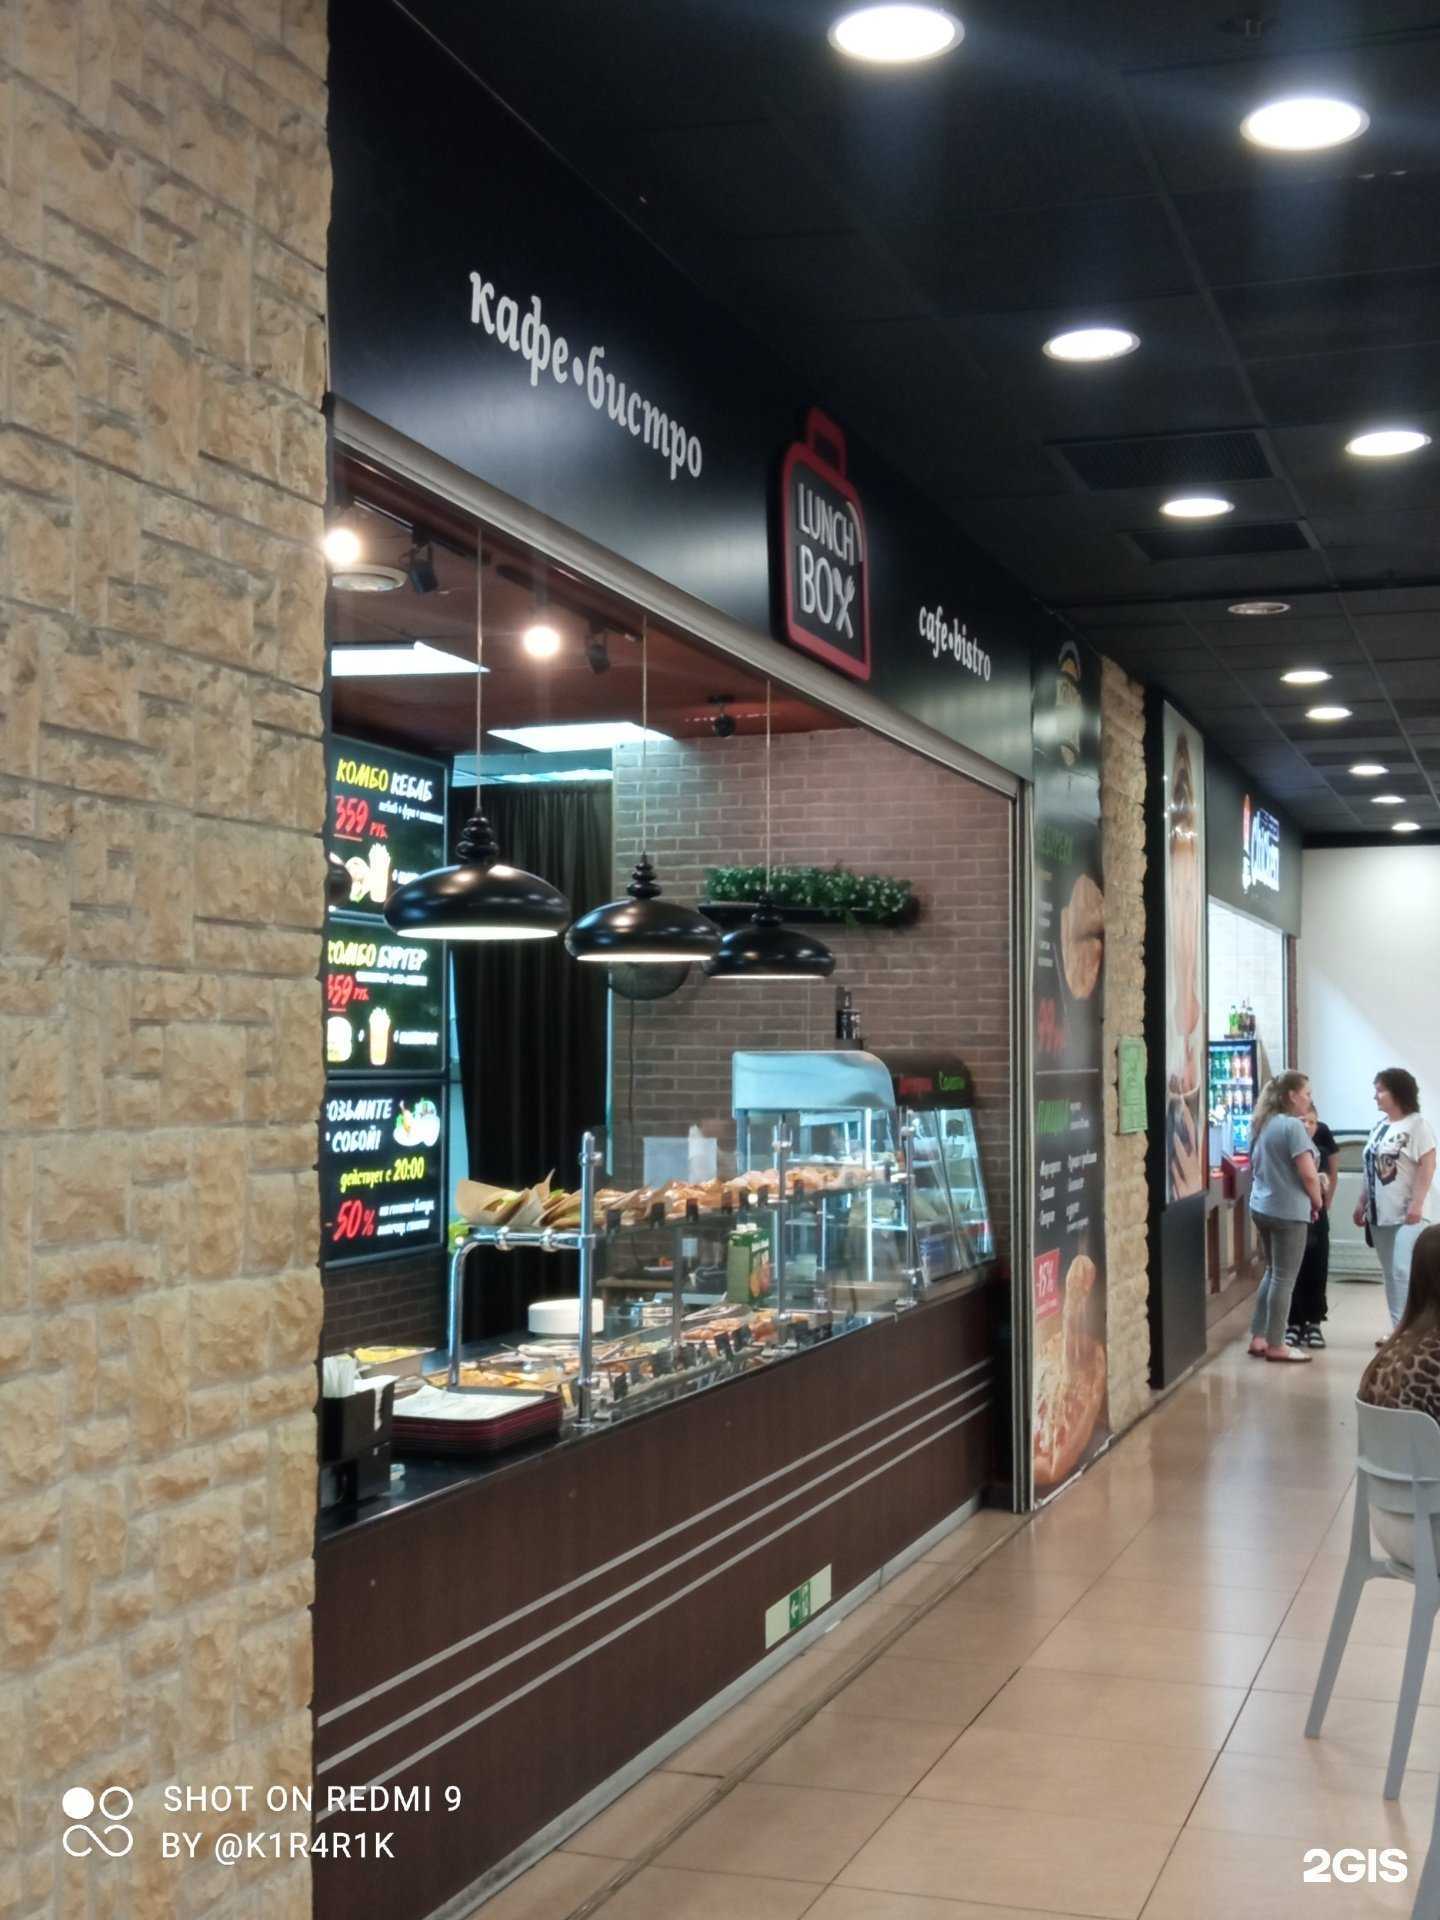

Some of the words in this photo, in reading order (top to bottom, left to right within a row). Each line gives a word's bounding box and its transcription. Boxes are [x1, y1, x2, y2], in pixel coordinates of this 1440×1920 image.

[798, 483, 857, 566] LUNCH
[800, 544, 856, 639] BOX
[336, 759, 389, 792] КОМБО
[390, 772, 433, 803] КЕБАБ
[335, 795, 369, 834] 359
[327, 1099, 392, 1122] ОЗЬМИТЕ
[332, 1125, 382, 1152] СОБОЙ
[393, 1156, 425, 1181] 20:00
